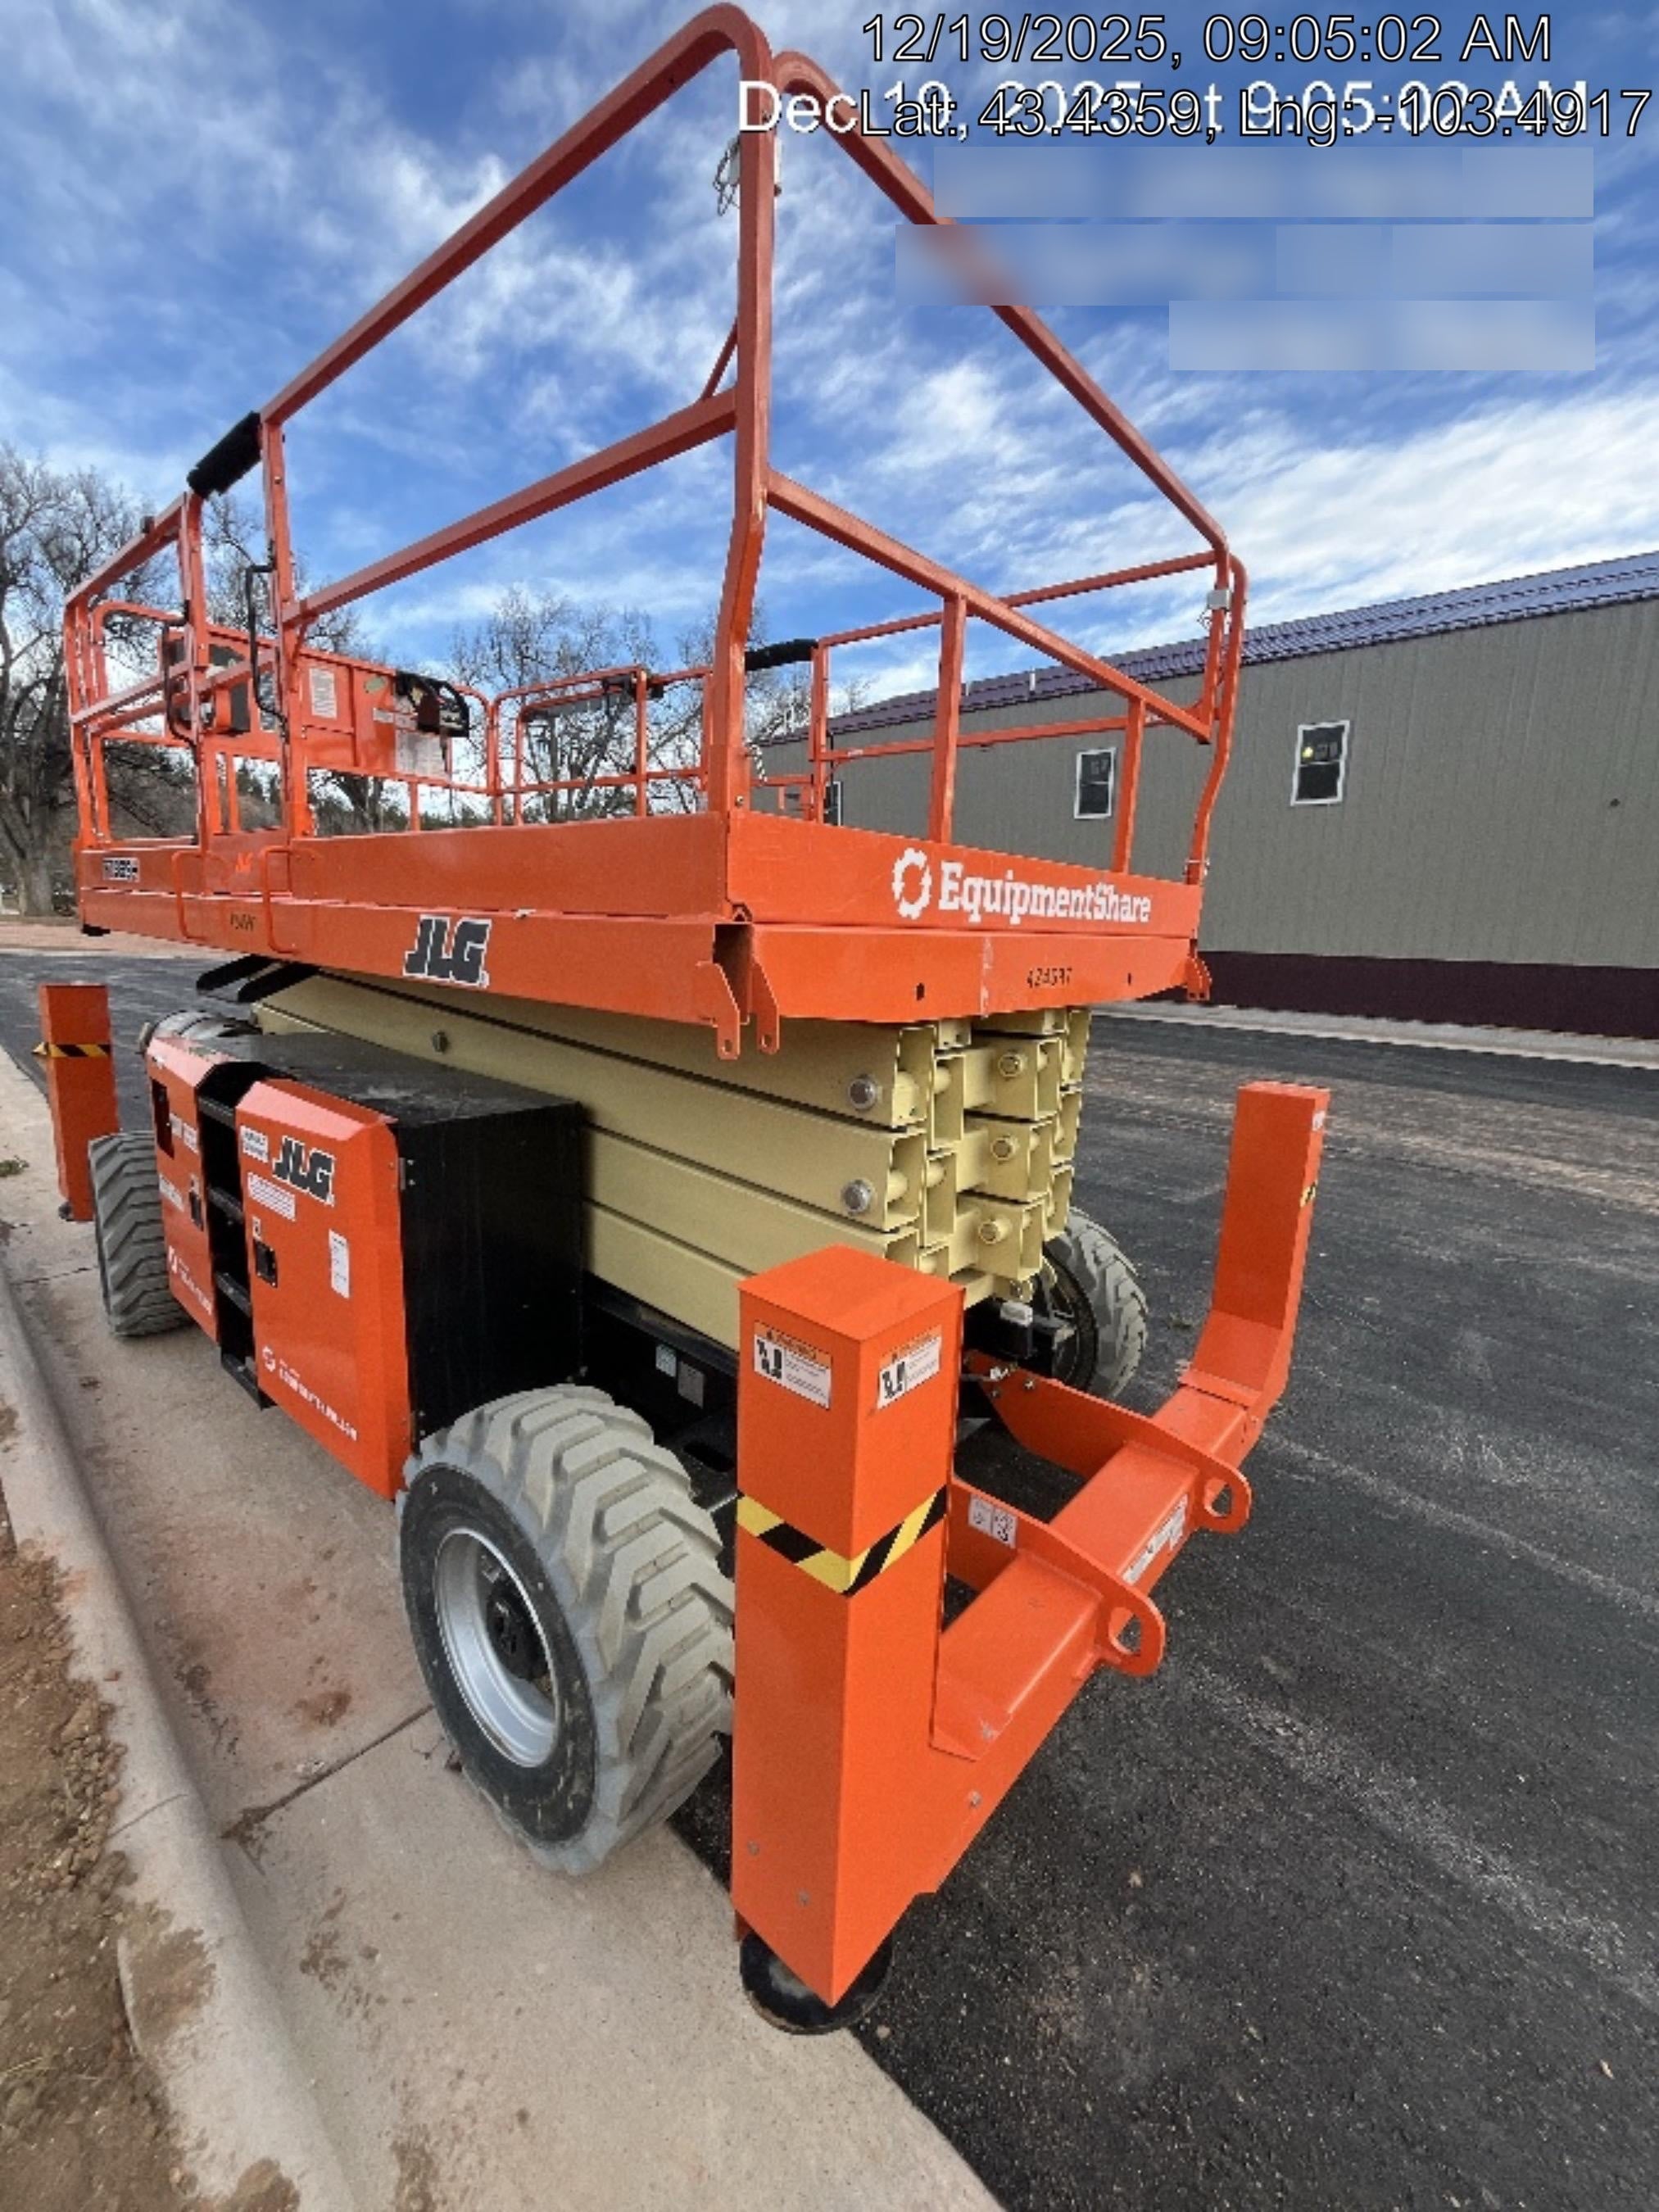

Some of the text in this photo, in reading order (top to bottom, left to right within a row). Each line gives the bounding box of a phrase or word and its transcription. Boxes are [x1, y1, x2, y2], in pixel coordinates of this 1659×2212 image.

[938, 860, 1151, 925] EquipmentShare
[402, 914, 492, 987] JLG
[271, 1135, 335, 1205] JLG
